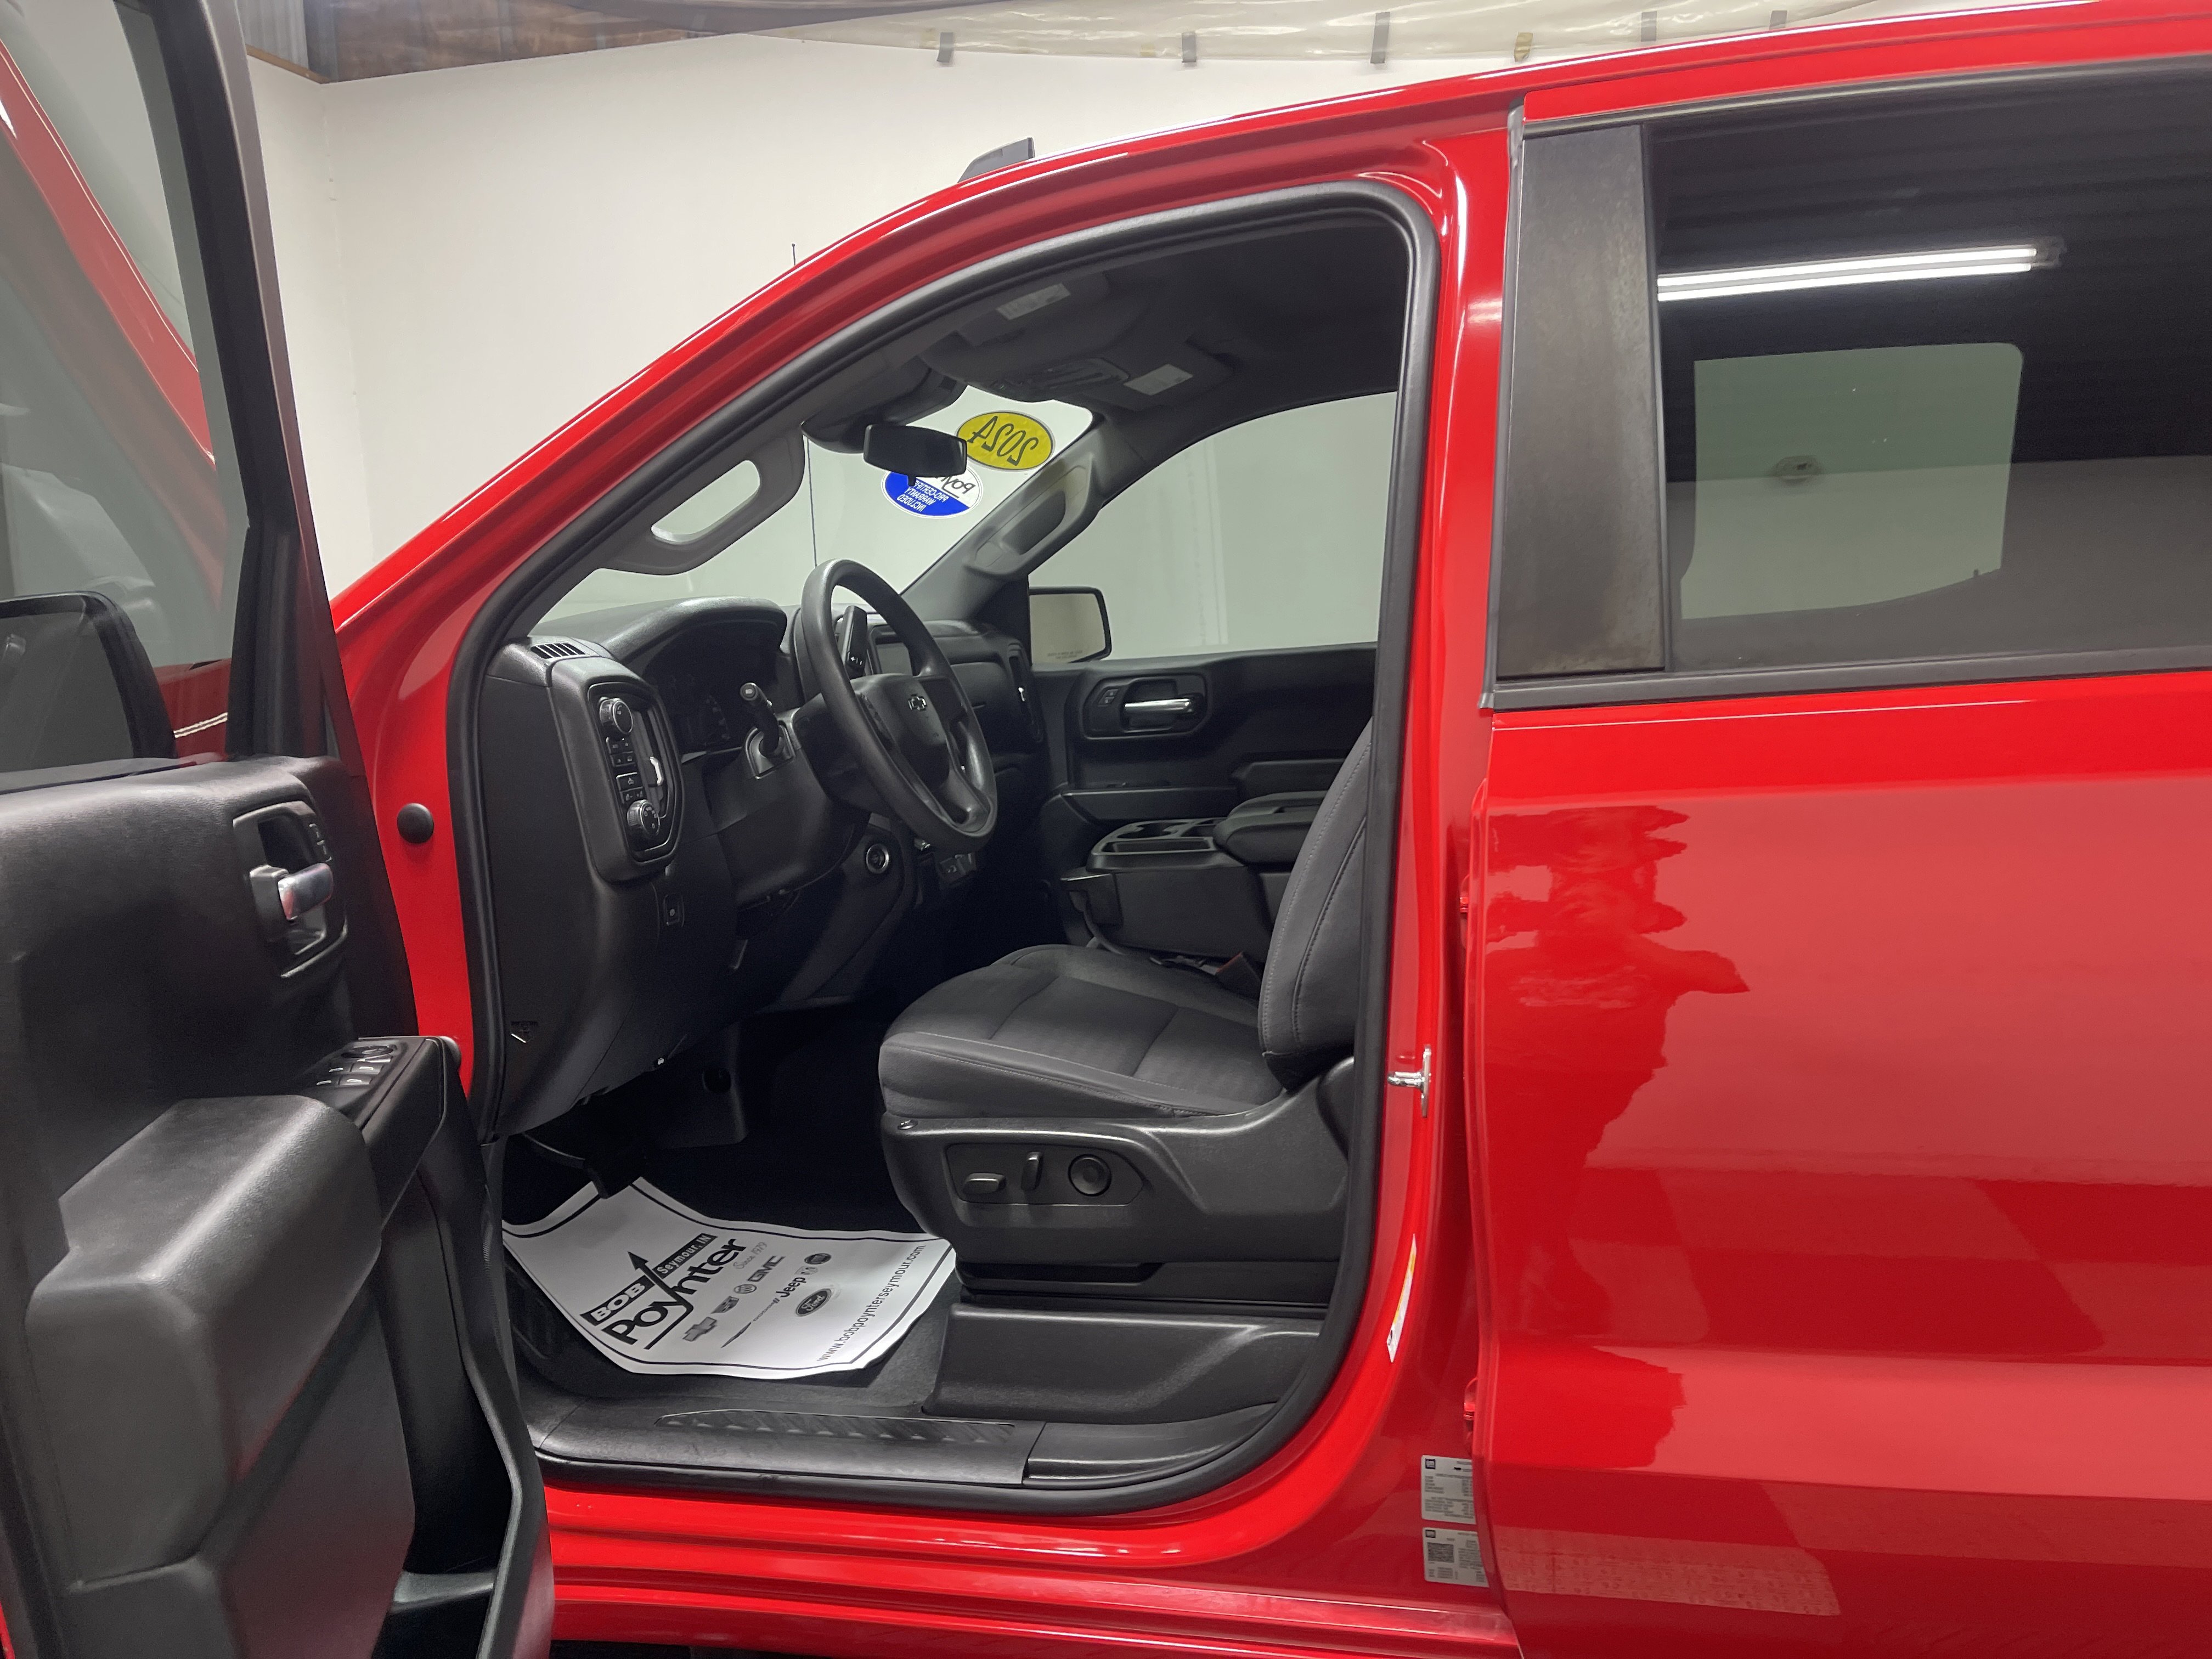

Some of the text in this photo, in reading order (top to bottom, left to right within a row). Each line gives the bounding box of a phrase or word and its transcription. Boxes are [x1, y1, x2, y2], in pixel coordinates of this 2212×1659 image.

[697, 1234, 712, 1245] IN
[747, 1255, 786, 1282] GMC
[601, 1238, 747, 1346] Poynter
[776, 1277, 806, 1297] Jeep
[590, 1283, 645, 1322] BOB
[801, 1295, 825, 1311] Ford
[816, 1245, 927, 1362] www.bobpoynterseymour.com
